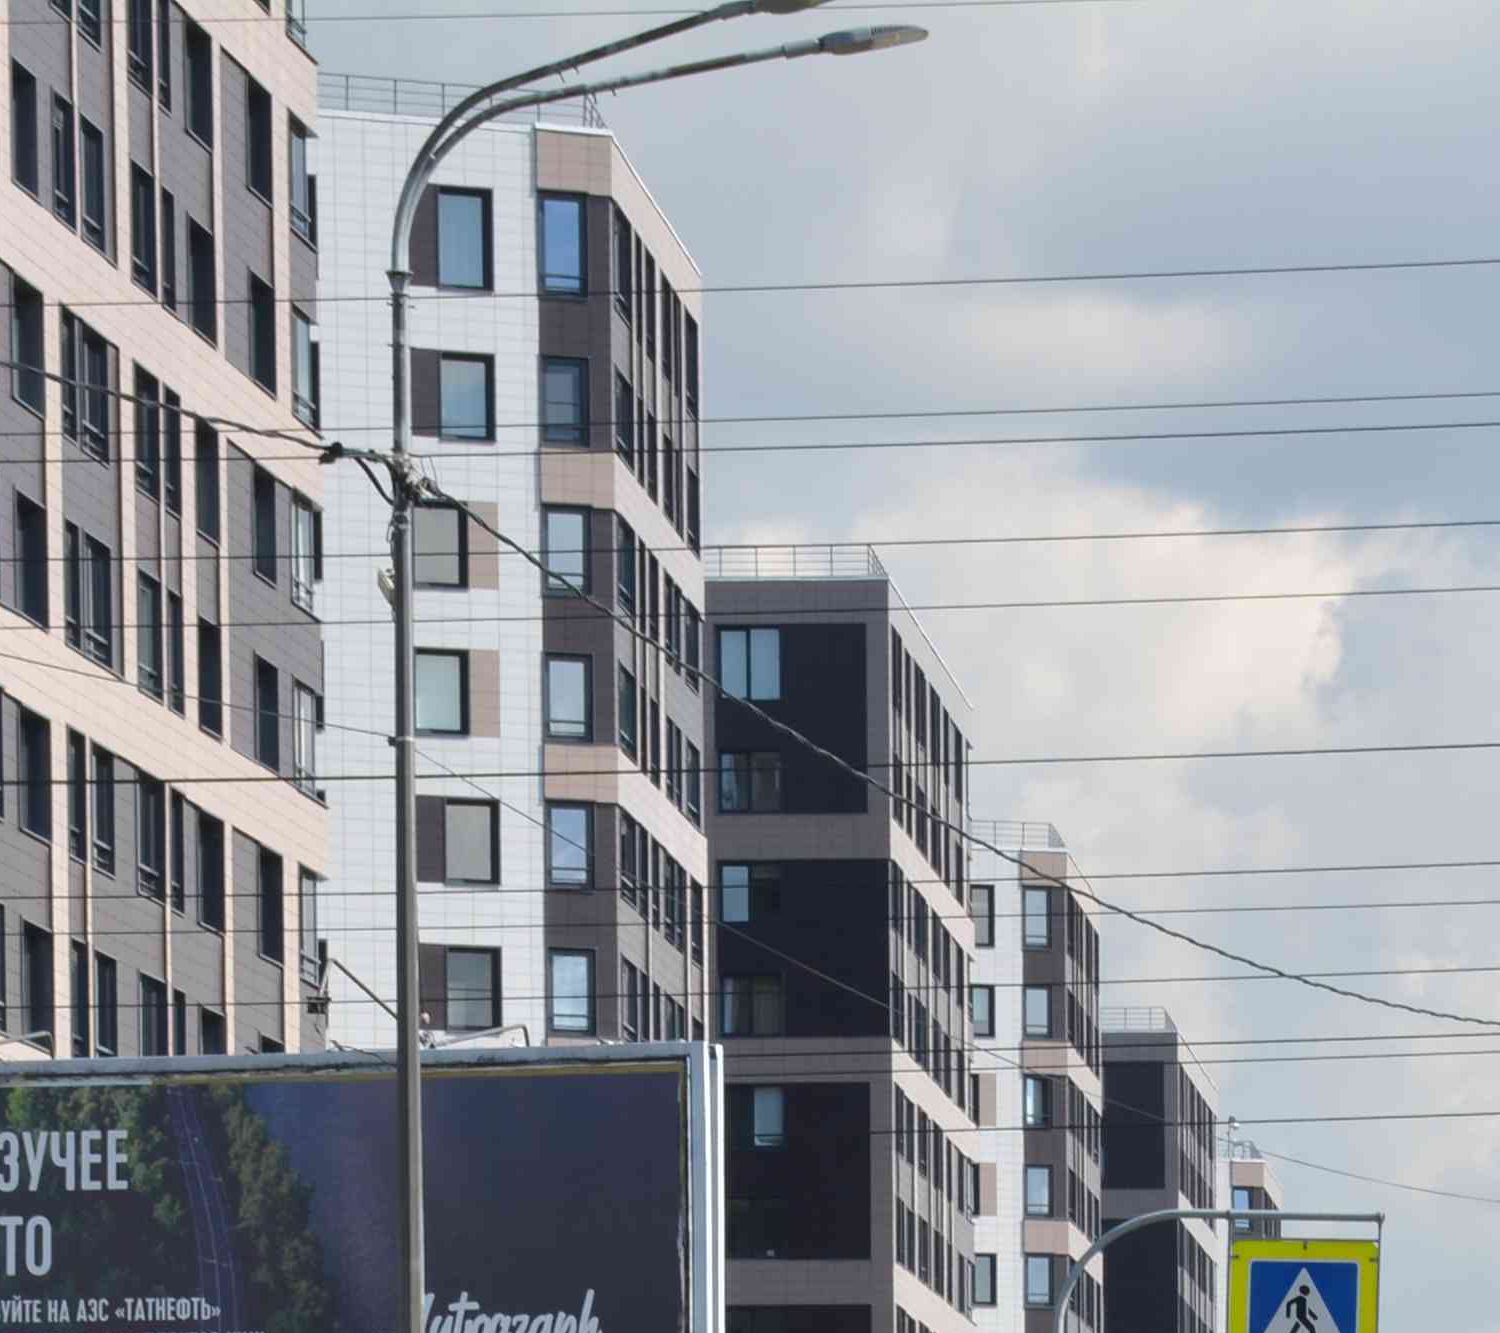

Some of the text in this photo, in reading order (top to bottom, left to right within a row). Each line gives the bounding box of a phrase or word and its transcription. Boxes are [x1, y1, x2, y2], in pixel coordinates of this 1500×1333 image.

[47, 1299, 70, 1323] НА
[76, 1298, 109, 1322] АЗС
[115, 1297, 222, 1321] «ТАТНЕФТЬ»
